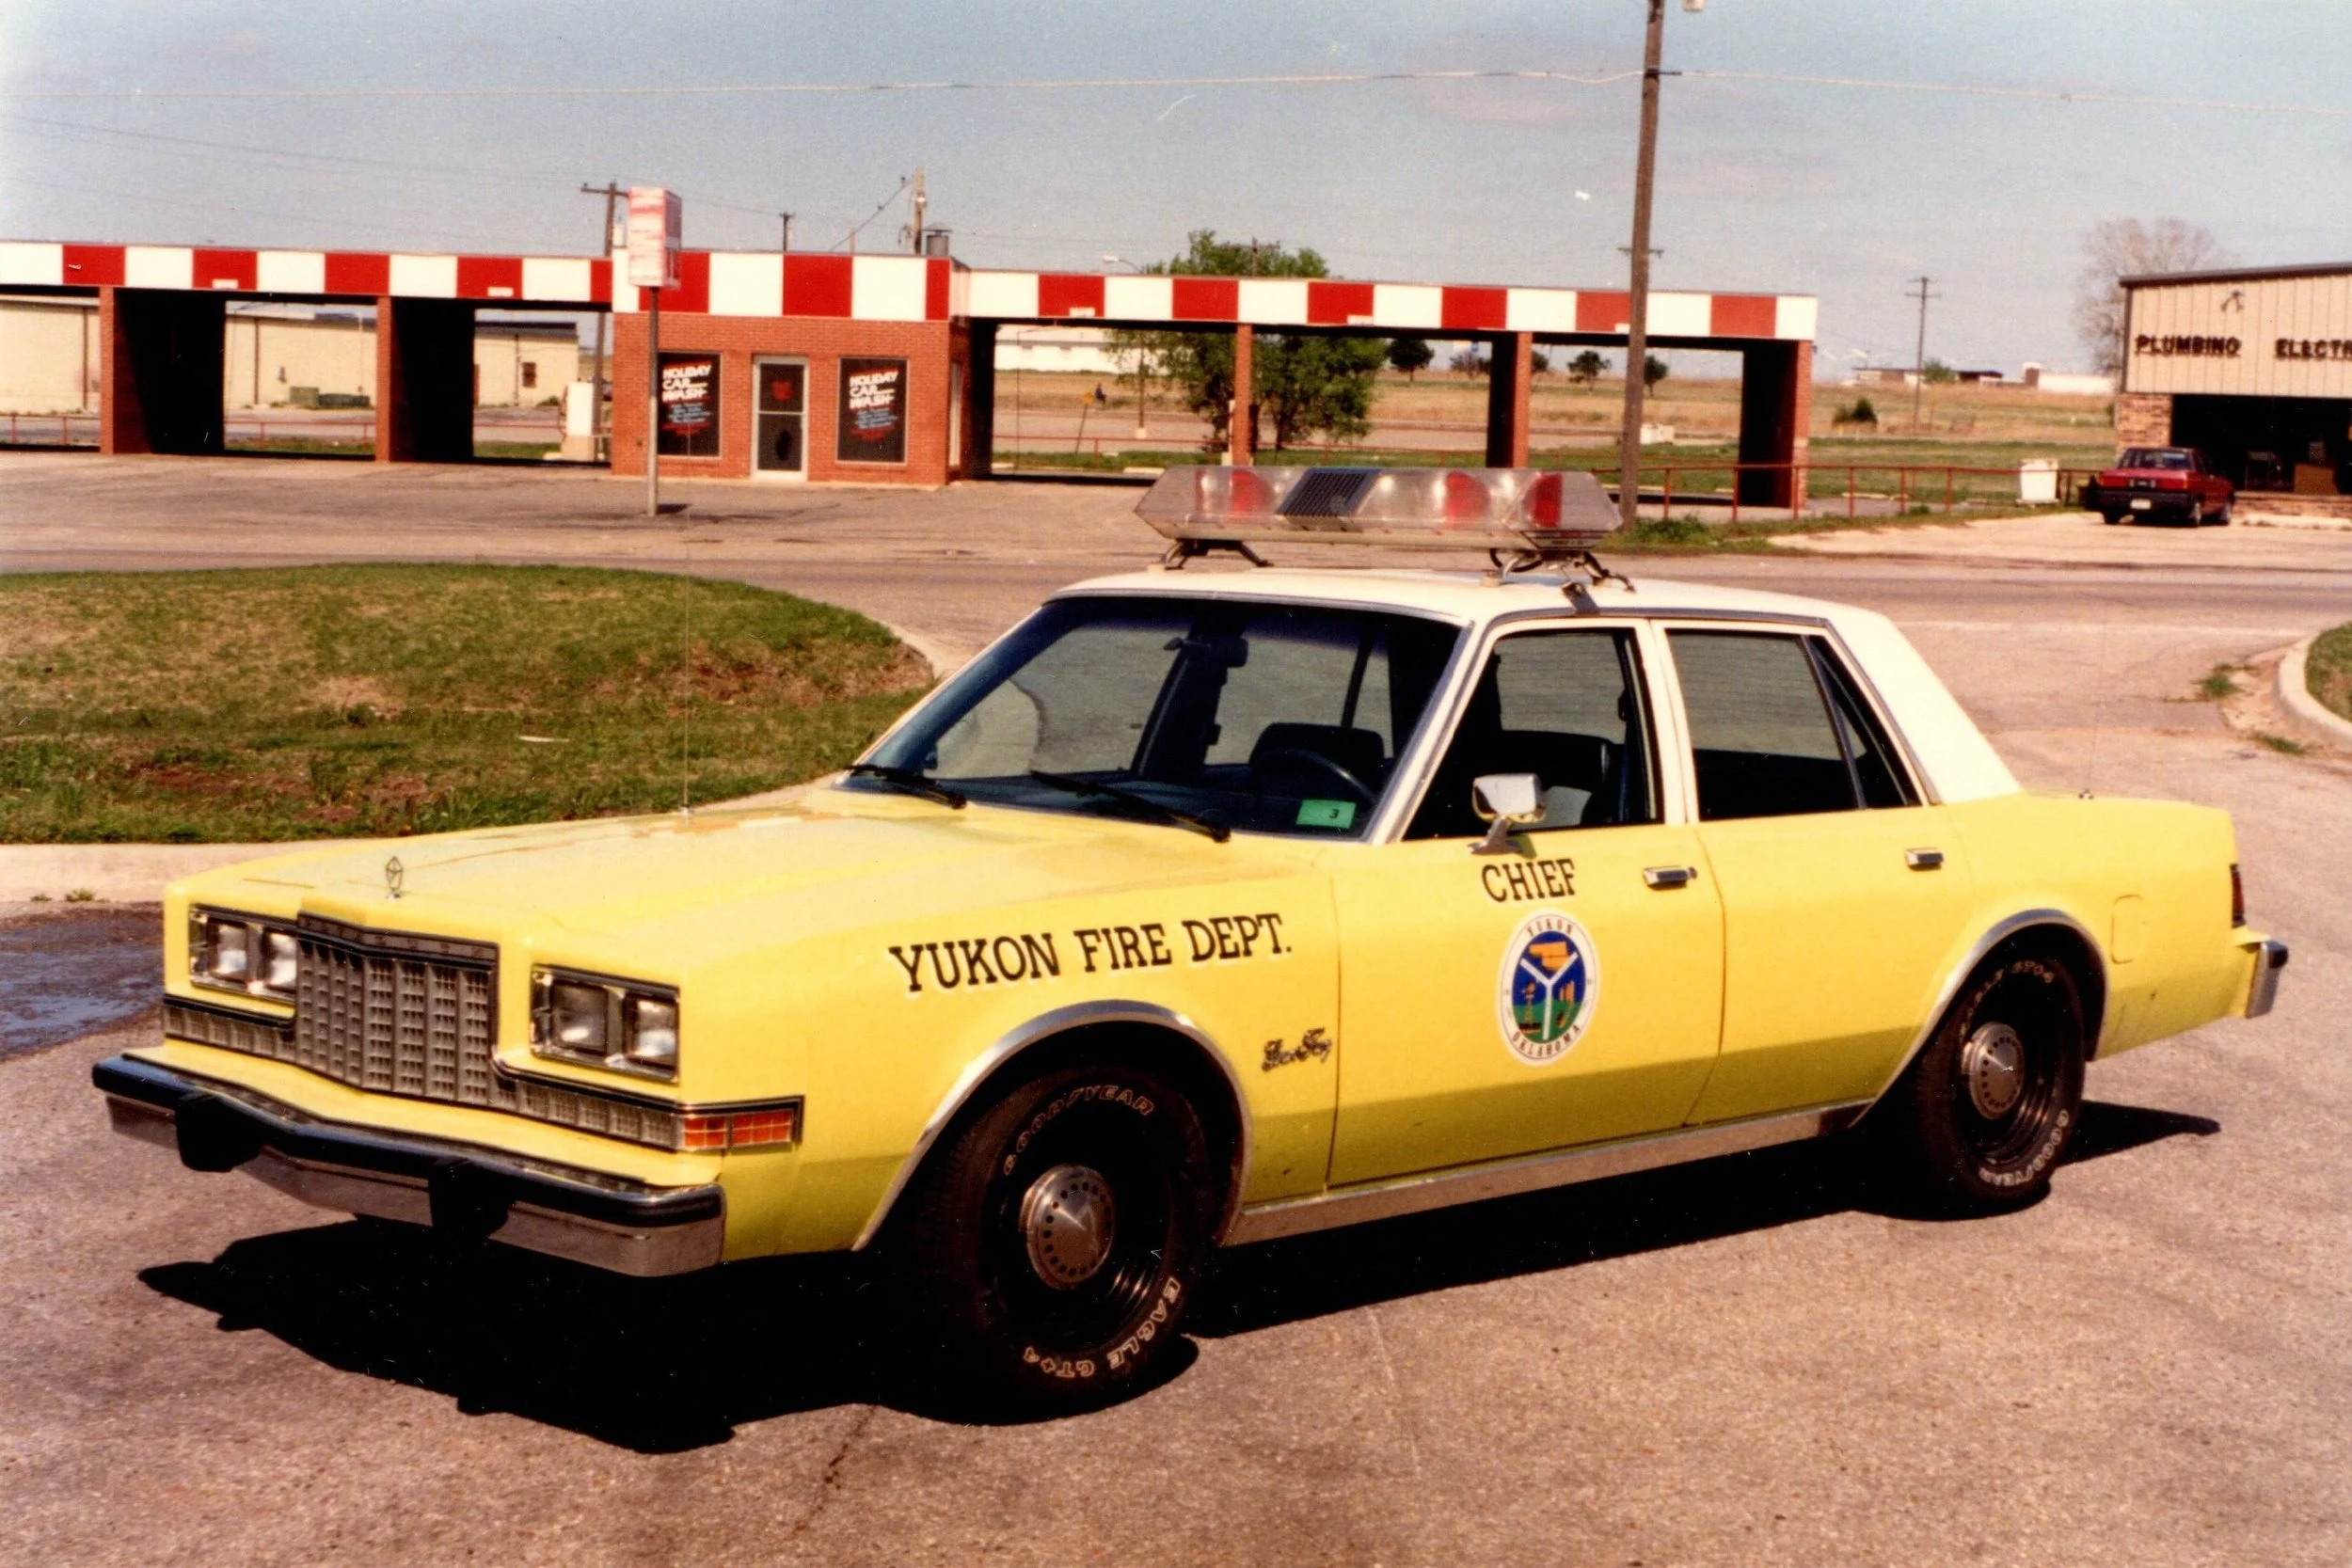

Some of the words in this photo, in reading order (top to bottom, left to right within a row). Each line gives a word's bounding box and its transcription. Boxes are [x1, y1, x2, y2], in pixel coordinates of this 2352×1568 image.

[662, 365, 711, 380] HOLIDAY
[850, 371, 898, 388] HOLIDAY
[1482, 858, 1576, 903] CHIEF
[1527, 918, 1574, 937] YUKON
[889, 931, 1060, 992] YUKON
[1073, 923, 1173, 973] FIRE
[1182, 912, 1293, 962] DEPT.
[1512, 1023, 1581, 1057] OKLAHOMA
[1004, 1085, 1155, 1176] GOODYEAR
[1106, 1275, 1181, 1370] EAGLE
